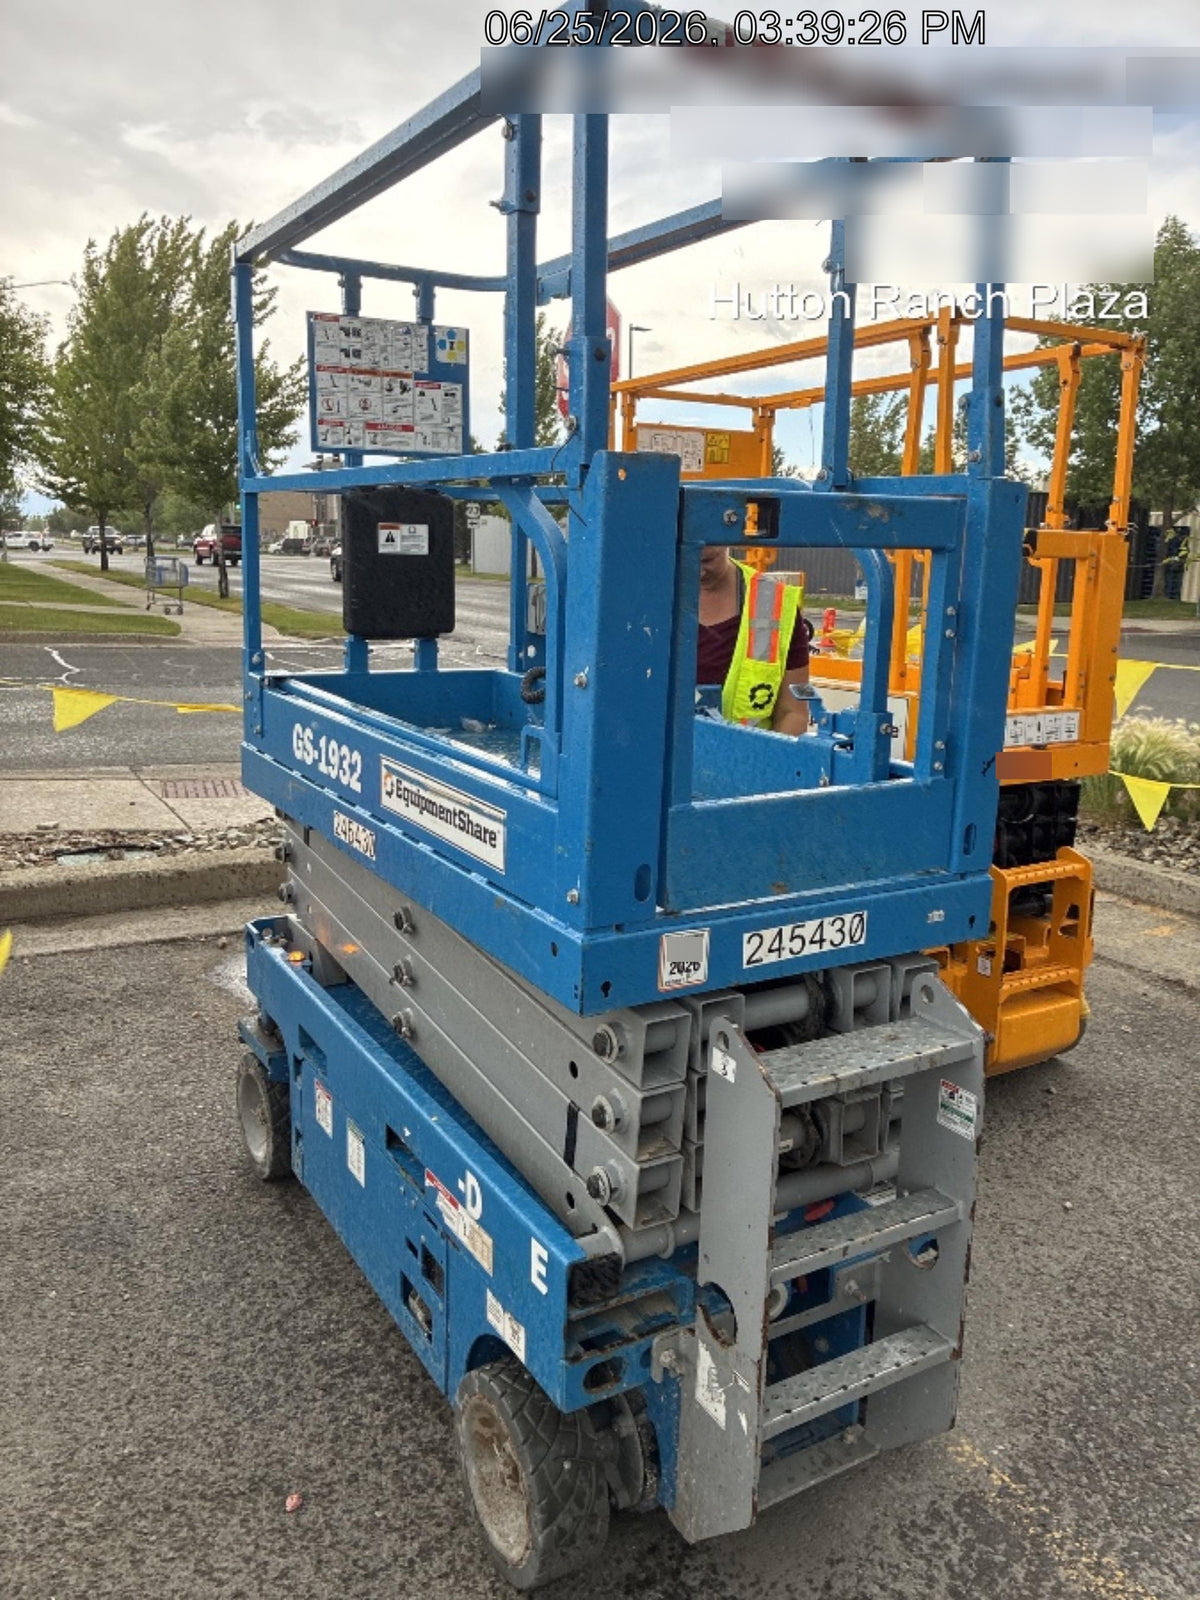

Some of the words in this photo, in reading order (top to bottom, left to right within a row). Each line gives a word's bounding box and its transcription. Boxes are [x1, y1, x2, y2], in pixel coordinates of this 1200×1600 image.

[292, 722, 362, 794] GS-1932
[395, 778, 497, 849] EquipmentShare
[745, 911, 866, 966] 245430
